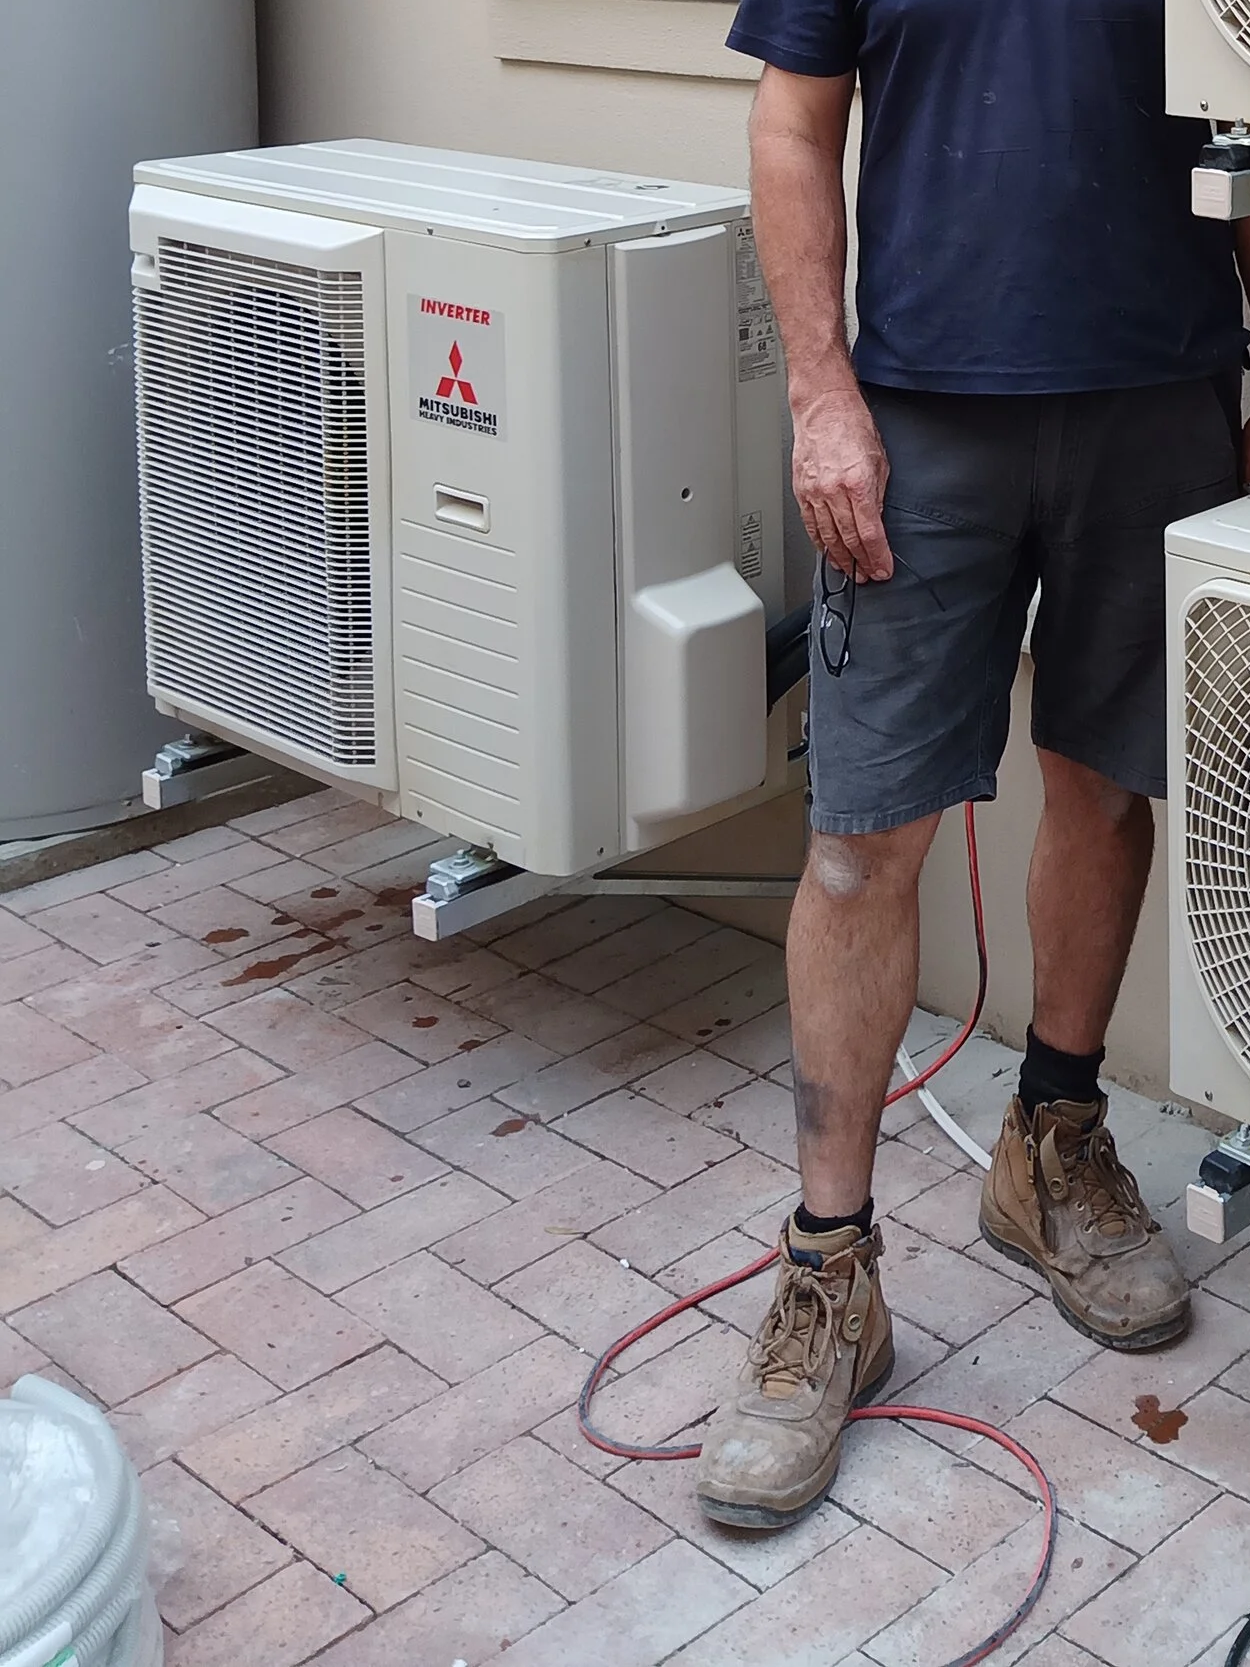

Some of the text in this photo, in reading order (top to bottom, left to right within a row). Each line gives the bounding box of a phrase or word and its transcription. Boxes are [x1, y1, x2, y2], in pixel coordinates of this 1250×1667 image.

[421, 298, 490, 326] INVERTER
[419, 397, 498, 427] MITSUBISHI
[419, 409, 498, 436] HEAVY INDUSTRIES
